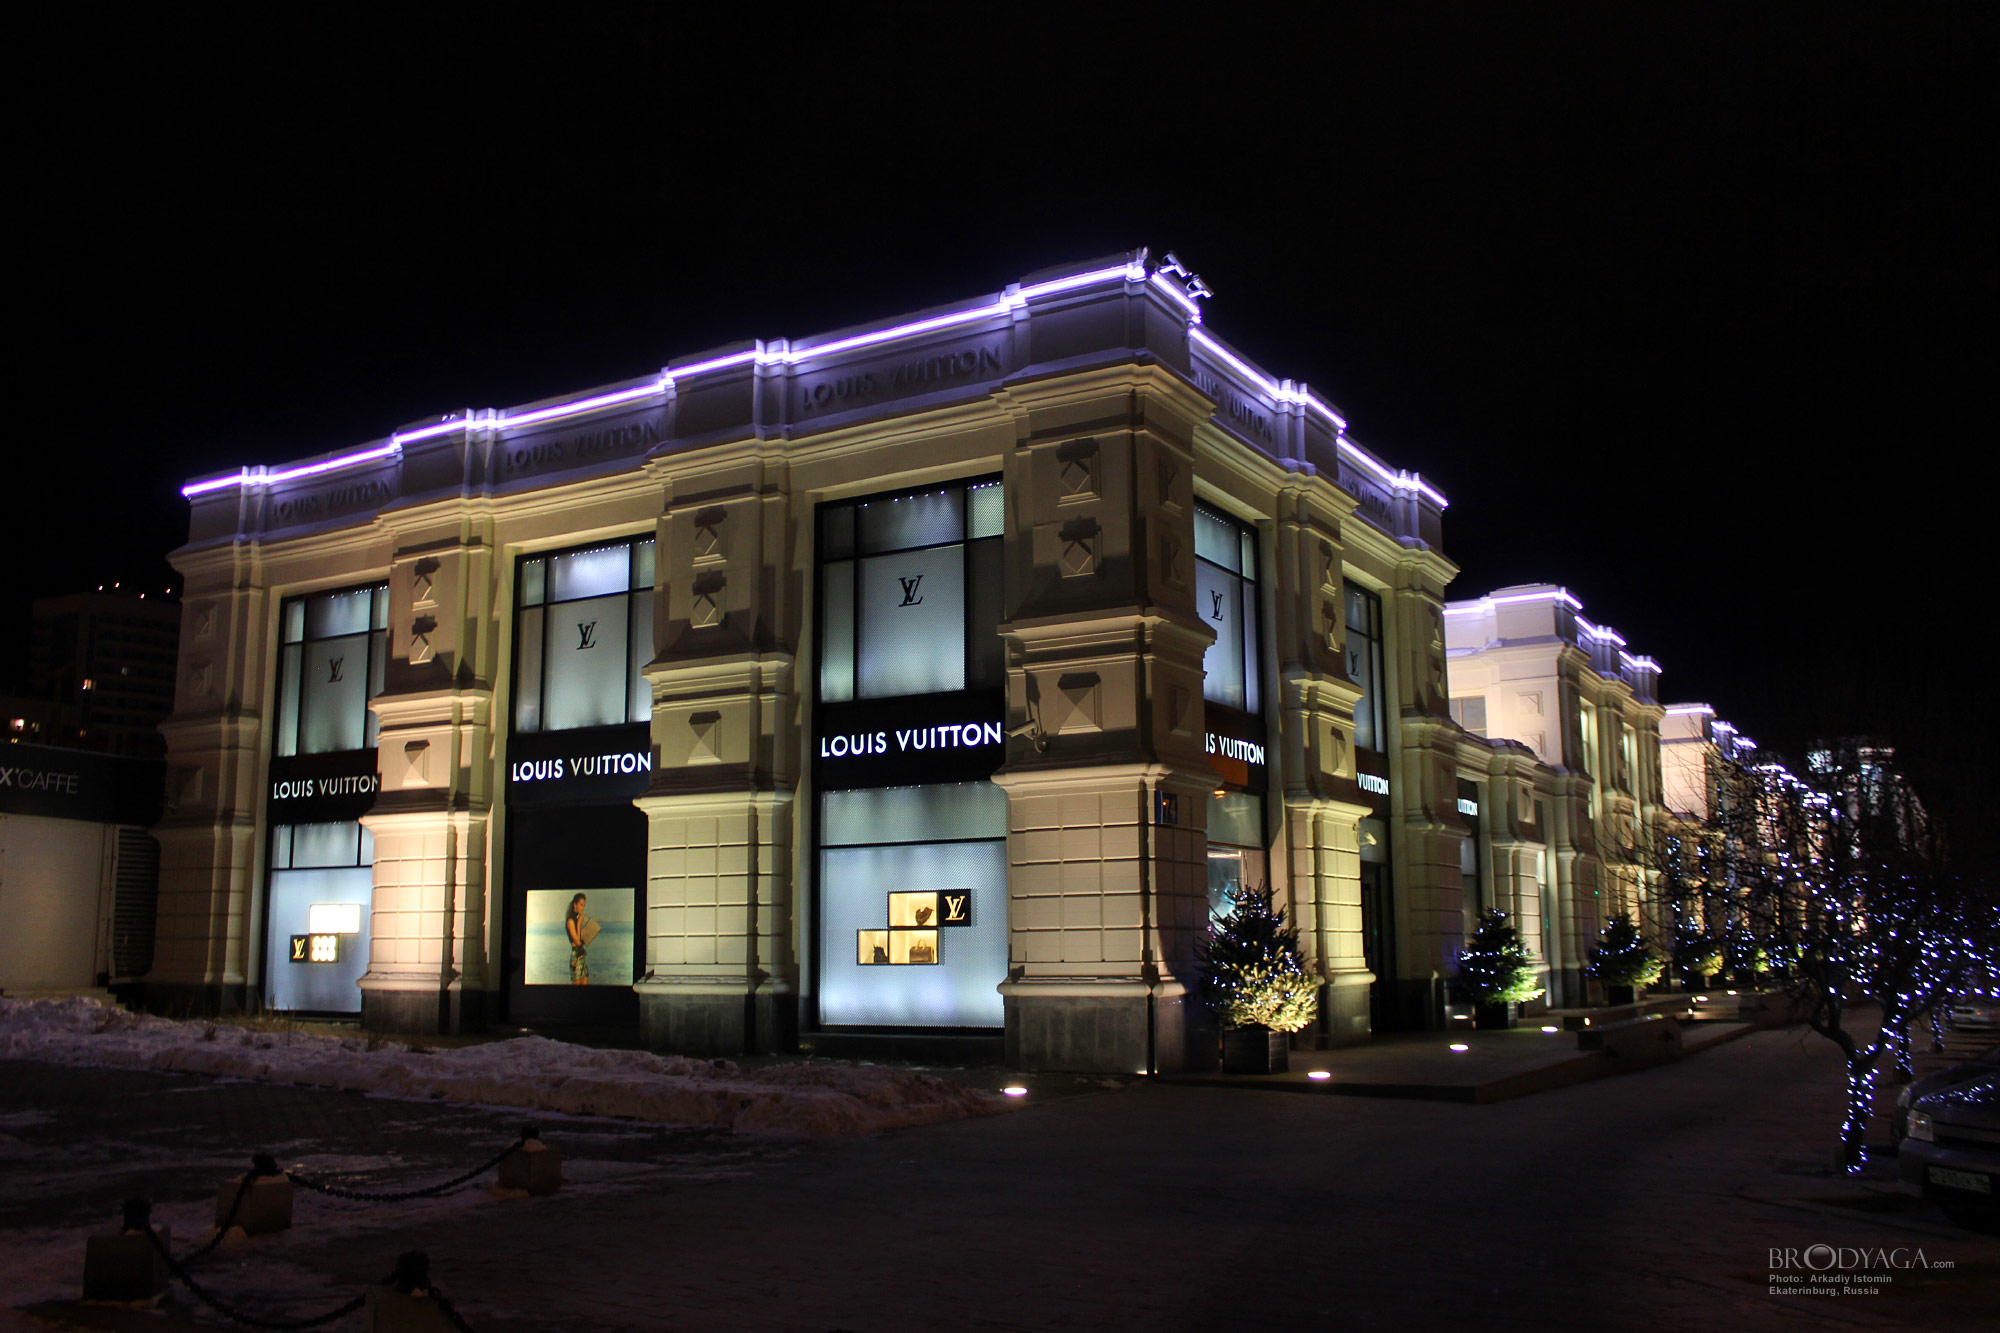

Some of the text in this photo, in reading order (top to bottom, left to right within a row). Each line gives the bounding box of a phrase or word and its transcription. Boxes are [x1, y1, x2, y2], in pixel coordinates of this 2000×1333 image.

[803, 345, 1001, 410] LOUIS VUITTON
[506, 421, 660, 472] LOUIS VUITTON
[274, 495, 317, 519] LOUIS
[821, 721, 1002, 757] LOUIS VUITTON
[1218, 735, 1265, 766] VUITTON
[512, 751, 652, 782] LOUIS VUITTON
[273, 775, 378, 799] LOUIS VUITTON
[1356, 772, 1389, 795] VUITTON
[1457, 798, 1479, 816] UITTON
